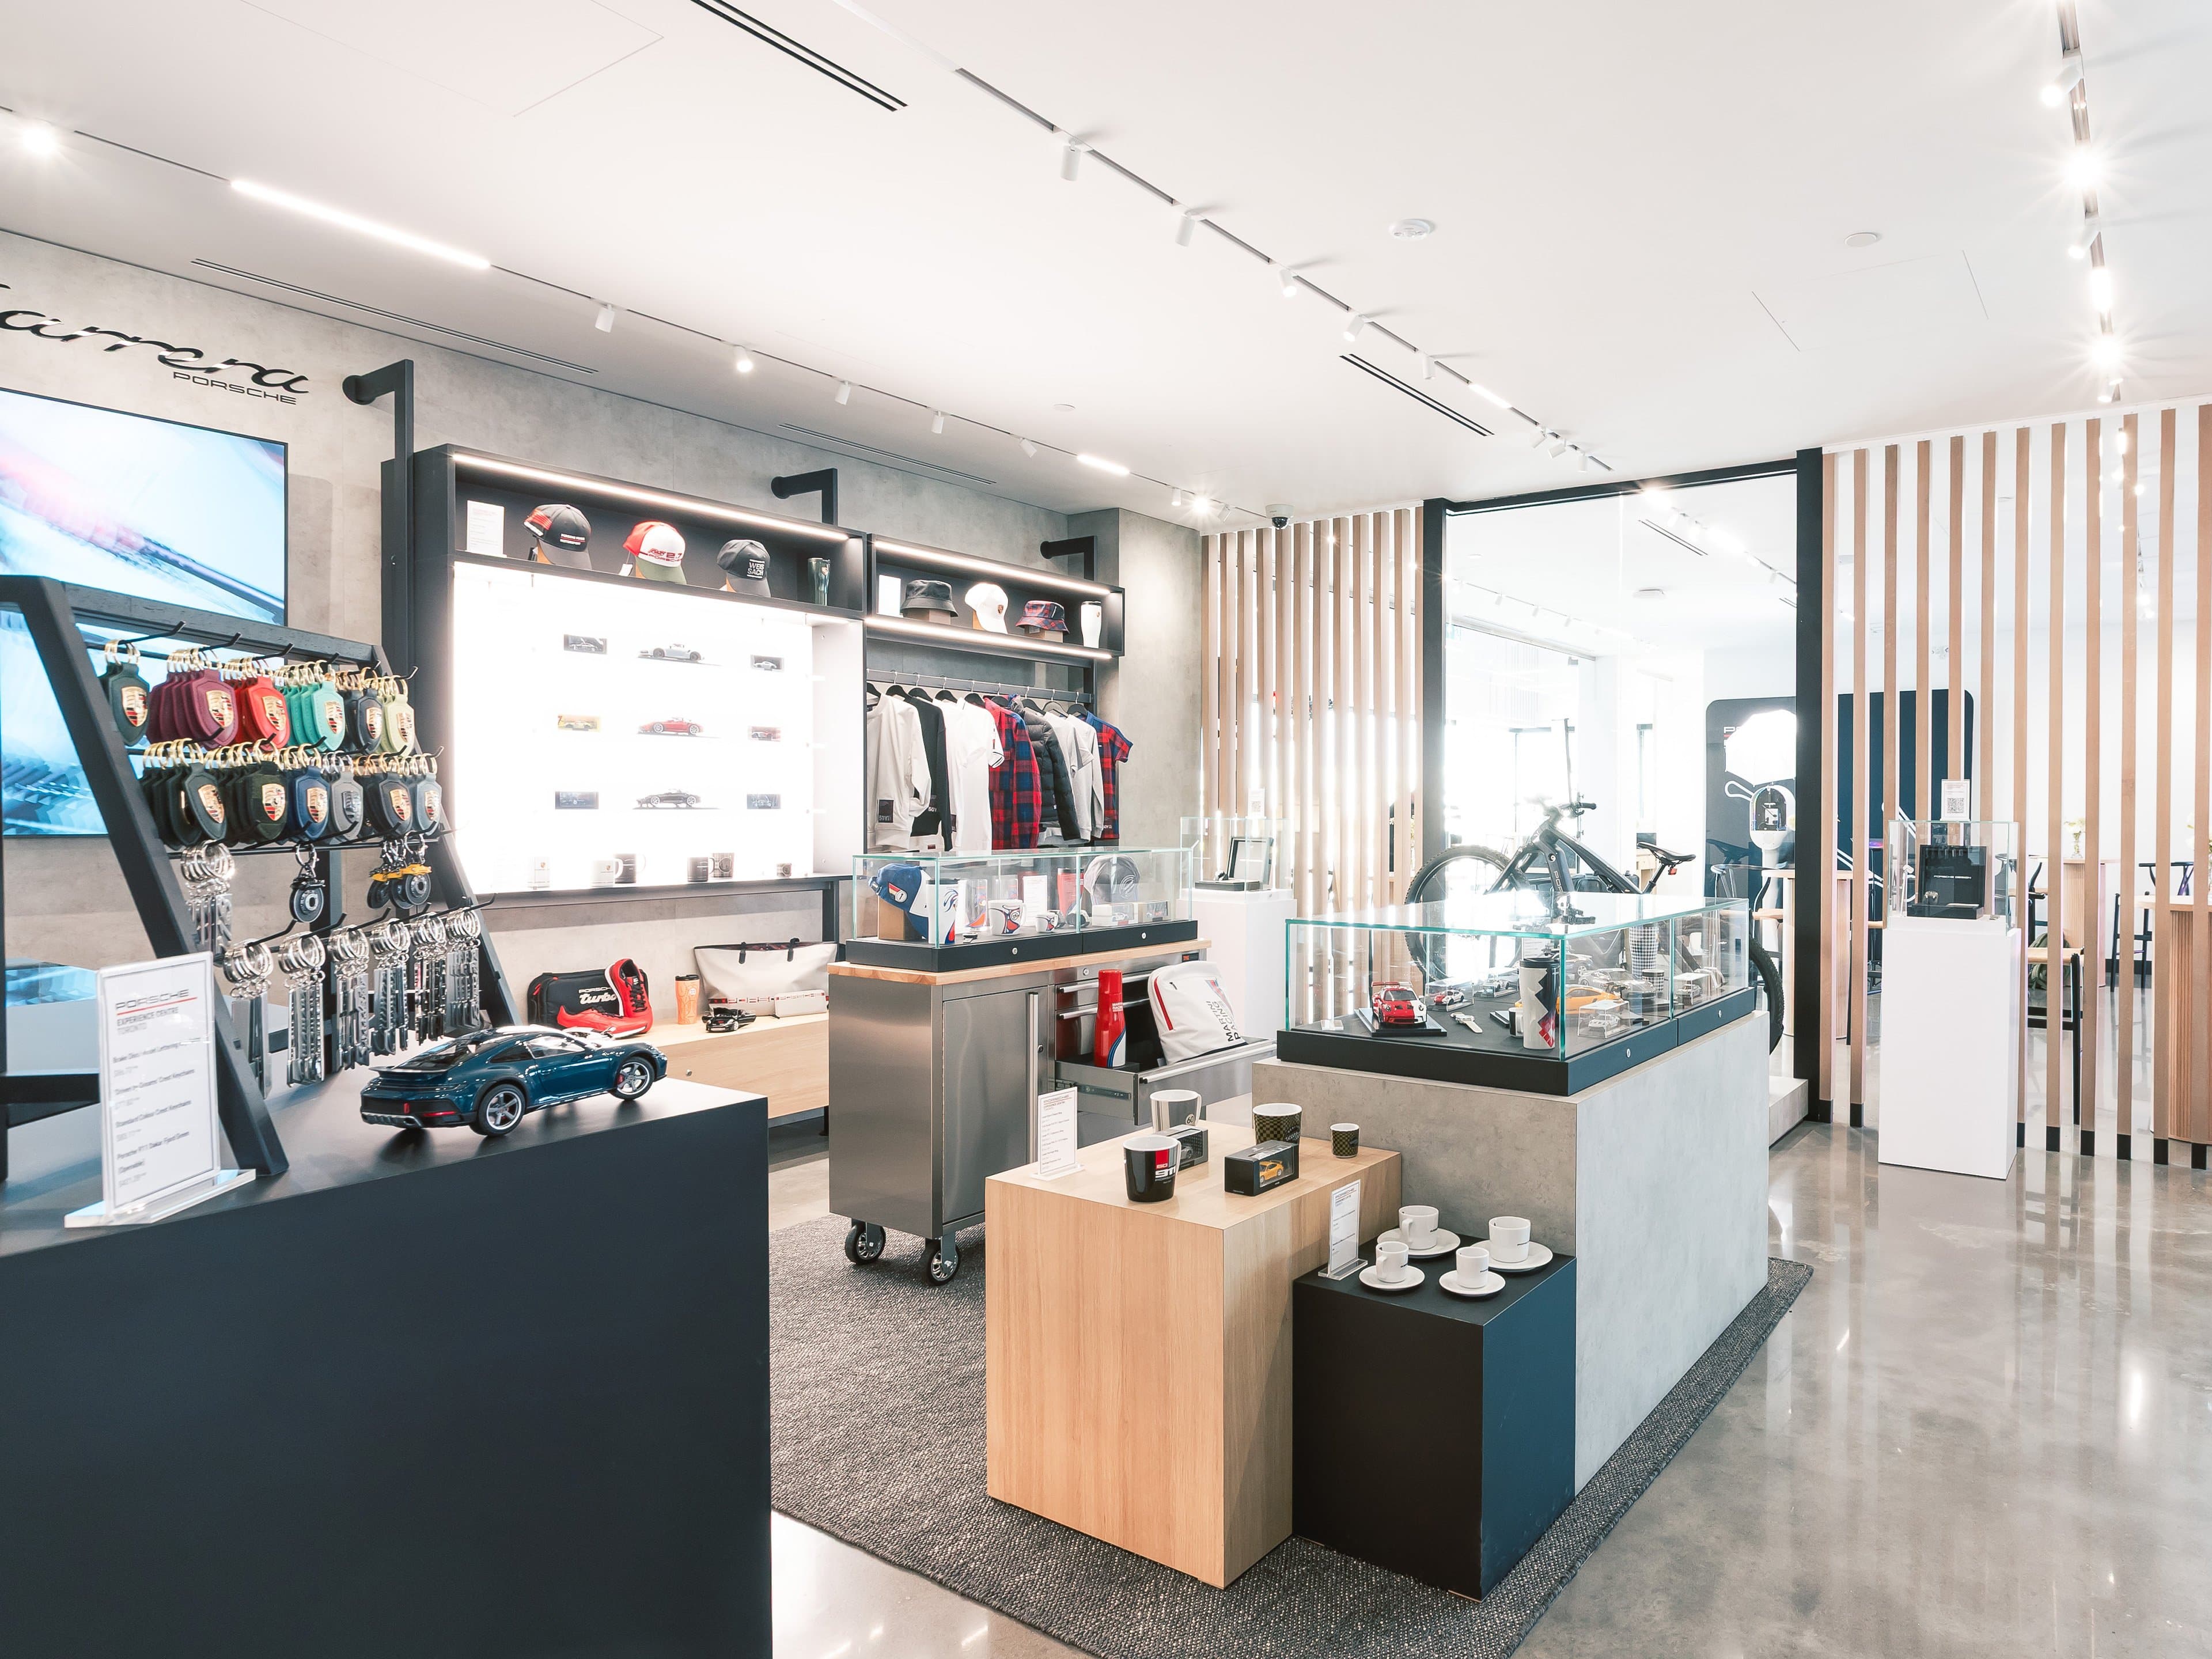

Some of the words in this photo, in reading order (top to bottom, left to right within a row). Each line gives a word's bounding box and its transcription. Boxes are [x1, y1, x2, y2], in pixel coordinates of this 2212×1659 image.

[0, 283, 309, 393] arrera
[173, 372, 297, 406] PORSCHE
[747, 568, 764, 576] SACH
[116, 989, 190, 1009] PORSCHE
[579, 992, 618, 1005] turbo
[117, 1012, 155, 1027] EXPERIENCE
[1206, 1001, 1234, 1041] MARTINI
[1187, 1116, 1194, 1124] 60
[1155, 1165, 1176, 1179] 911
